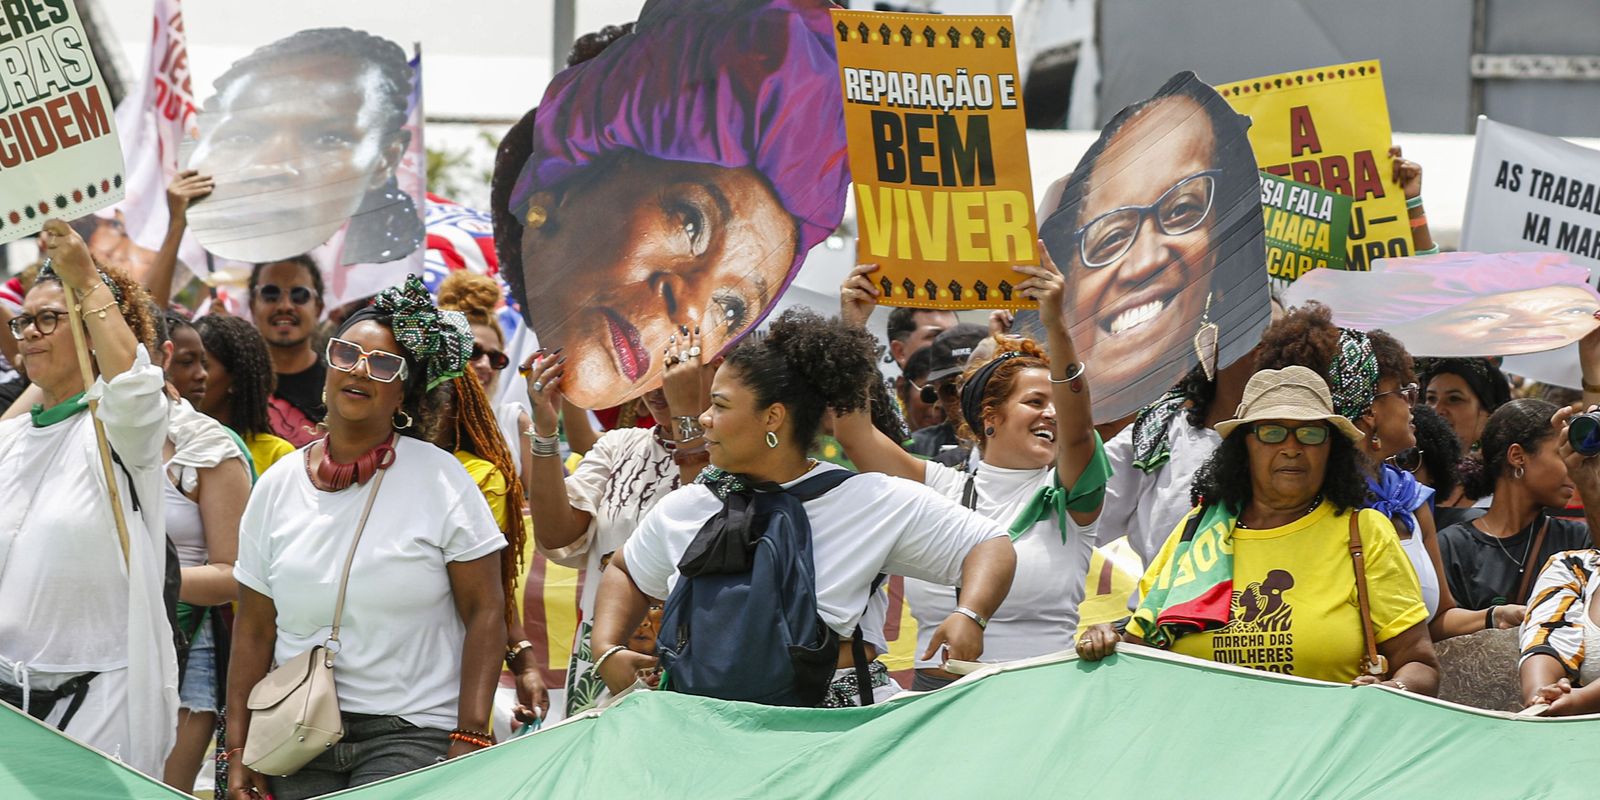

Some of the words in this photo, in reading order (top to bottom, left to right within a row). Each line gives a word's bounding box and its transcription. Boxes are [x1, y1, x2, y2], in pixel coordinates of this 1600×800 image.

[844, 67, 993, 112] REPARAÇÃO
[998, 74, 1017, 109] E
[871, 110, 996, 187] BEM
[1290, 105, 1322, 157] A
[1259, 150, 1385, 201] RRA
[1494, 160, 1523, 192] AS
[857, 184, 1033, 262] VIVER
[1286, 186, 1333, 223] FALA
[1522, 212, 1551, 245] NA
[952, 347, 972, 356] NIKE
[1213, 634, 1264, 648] MARCHA
[1270, 633, 1293, 646] DAS
[1214, 648, 1293, 664] MULHERES
